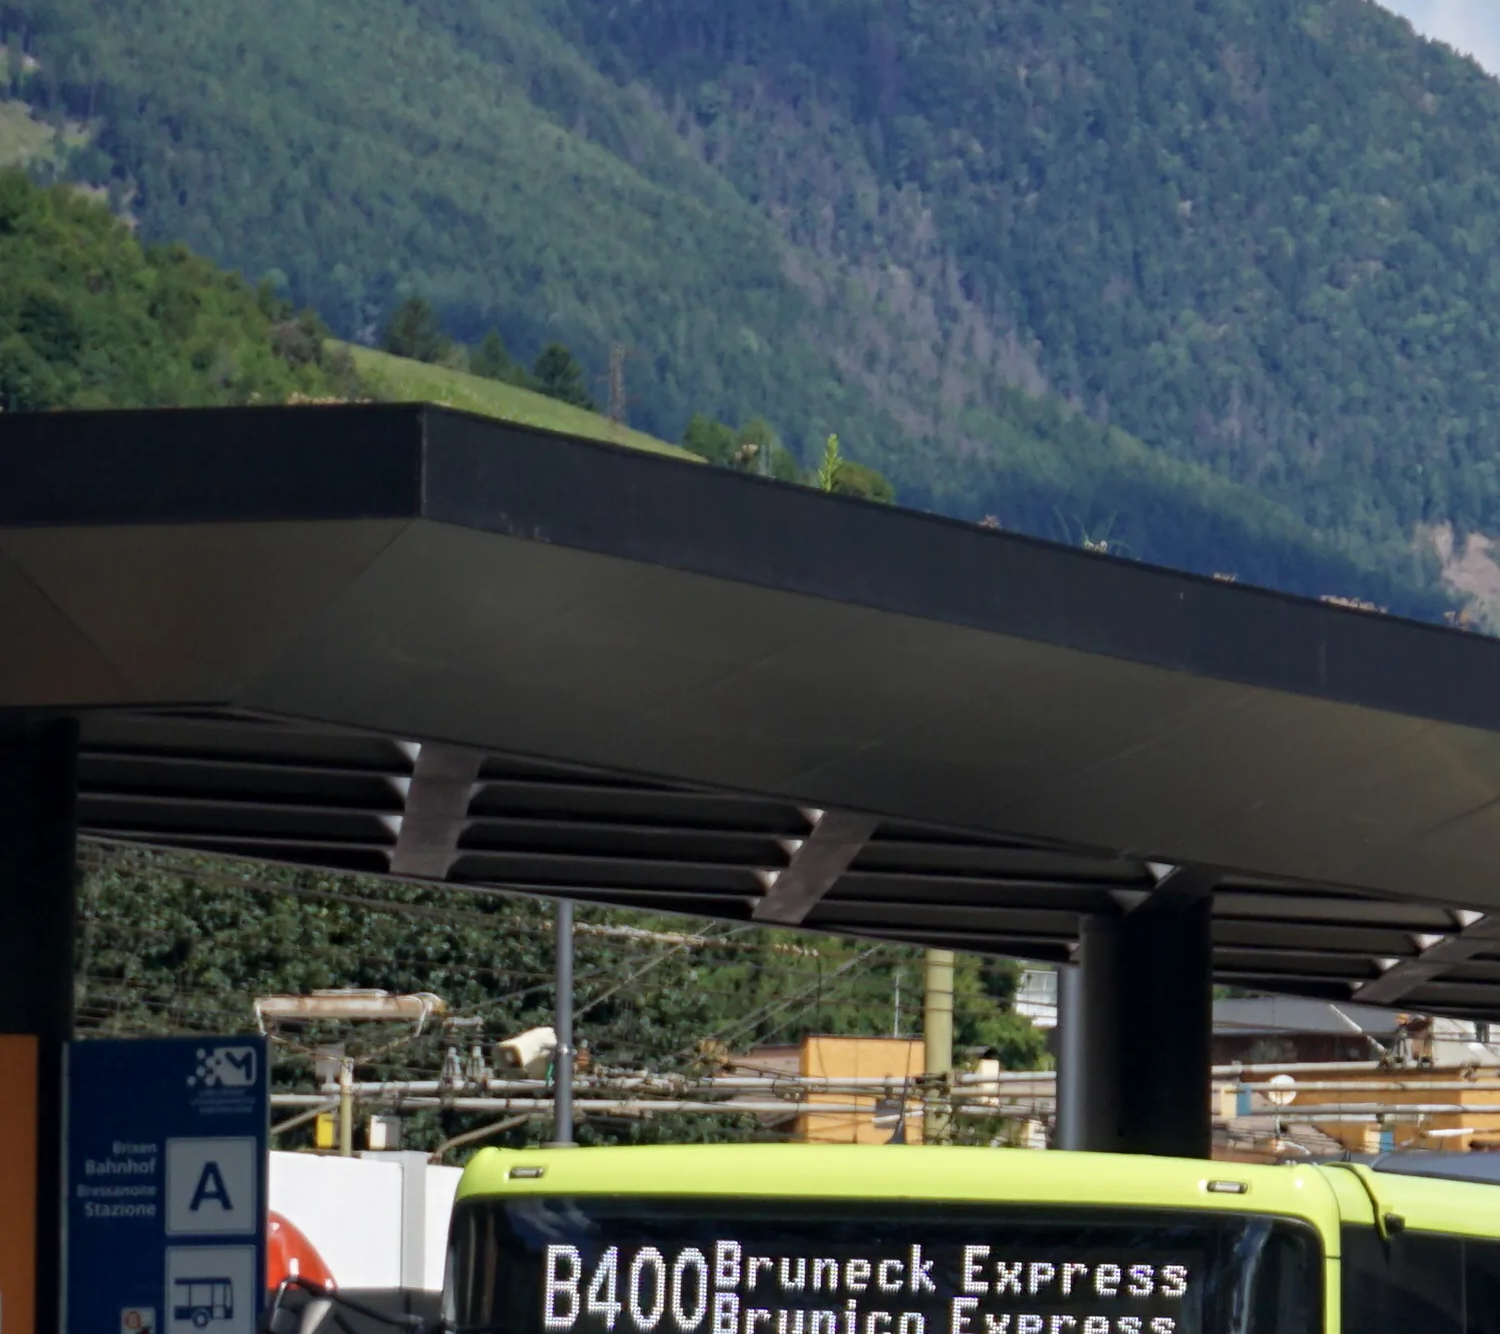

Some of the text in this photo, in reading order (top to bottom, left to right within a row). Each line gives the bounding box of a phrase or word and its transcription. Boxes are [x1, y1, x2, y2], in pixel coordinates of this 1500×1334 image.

[85, 1158, 157, 1176] Bahnhof
[189, 1161, 234, 1211] A
[84, 1202, 157, 1218] Stazione
[544, 1243, 708, 1332] B400
[713, 1240, 1188, 1297] Bruneck Express
